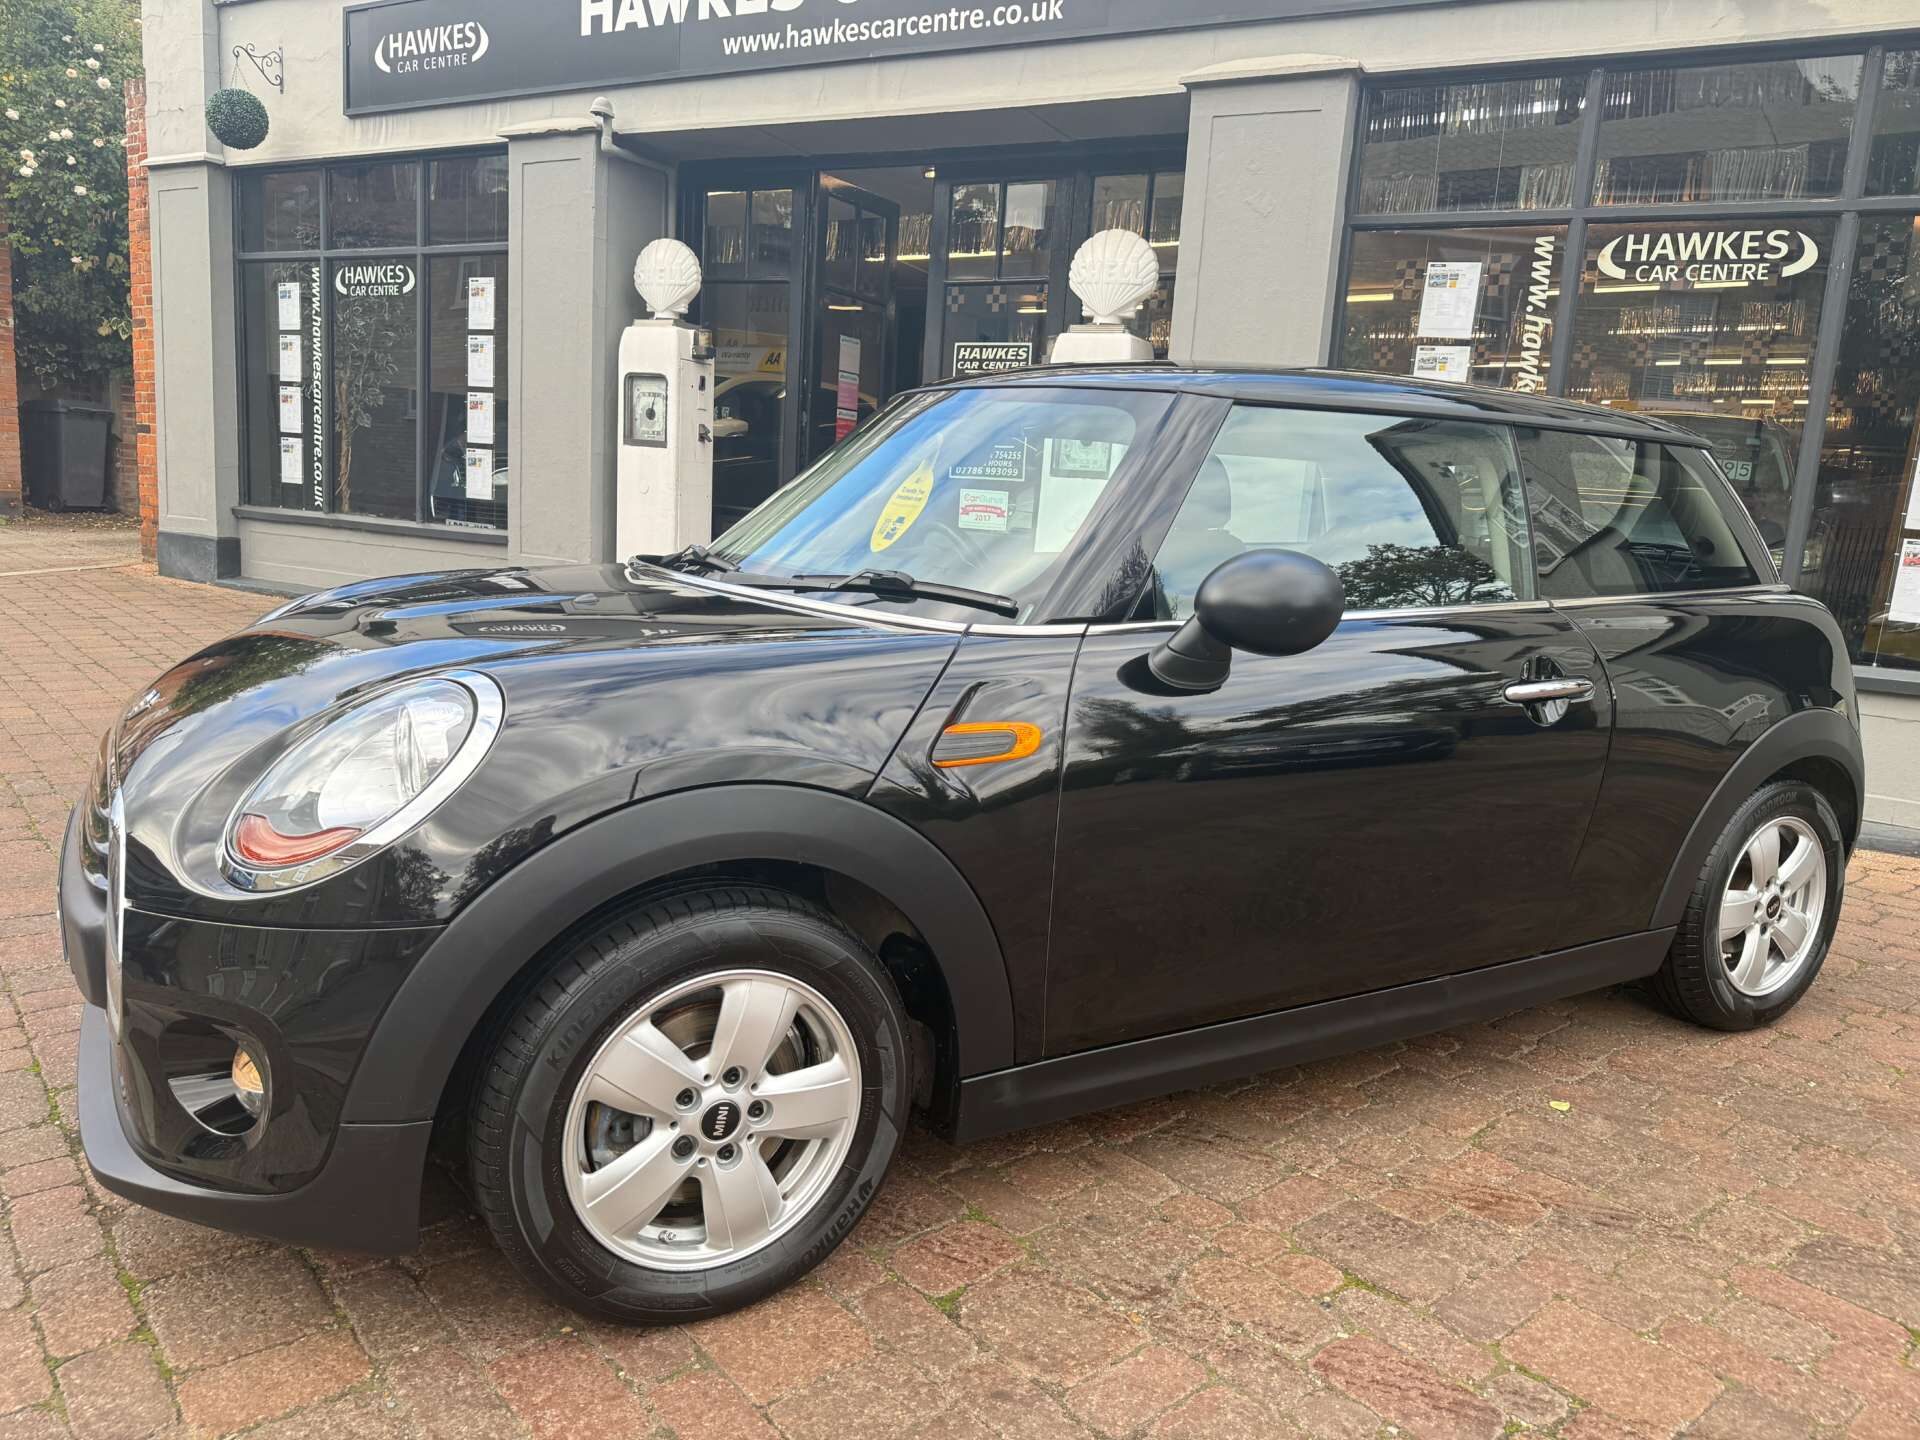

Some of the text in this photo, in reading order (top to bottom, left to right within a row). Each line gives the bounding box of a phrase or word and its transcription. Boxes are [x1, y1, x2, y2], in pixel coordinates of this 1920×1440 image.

[722, 0, 1064, 55] www.hawkescarcentre.co.uk
[389, 21, 476, 58] HAWKES
[397, 52, 468, 73] CAR CENTRE
[1624, 229, 1791, 262] HAWKES
[344, 264, 405, 285] HAWKES
[1635, 262, 1771, 282] CAR CENTRE
[350, 284, 400, 297] CAR CENTRE
[764, 352, 782, 366] AA
[958, 347, 1029, 360] HAWKES
[957, 361, 980, 369] CAR
[311, 266, 323, 507] www.hawkescarcentre.co.uk
[712, 1106, 730, 1136] MINI
